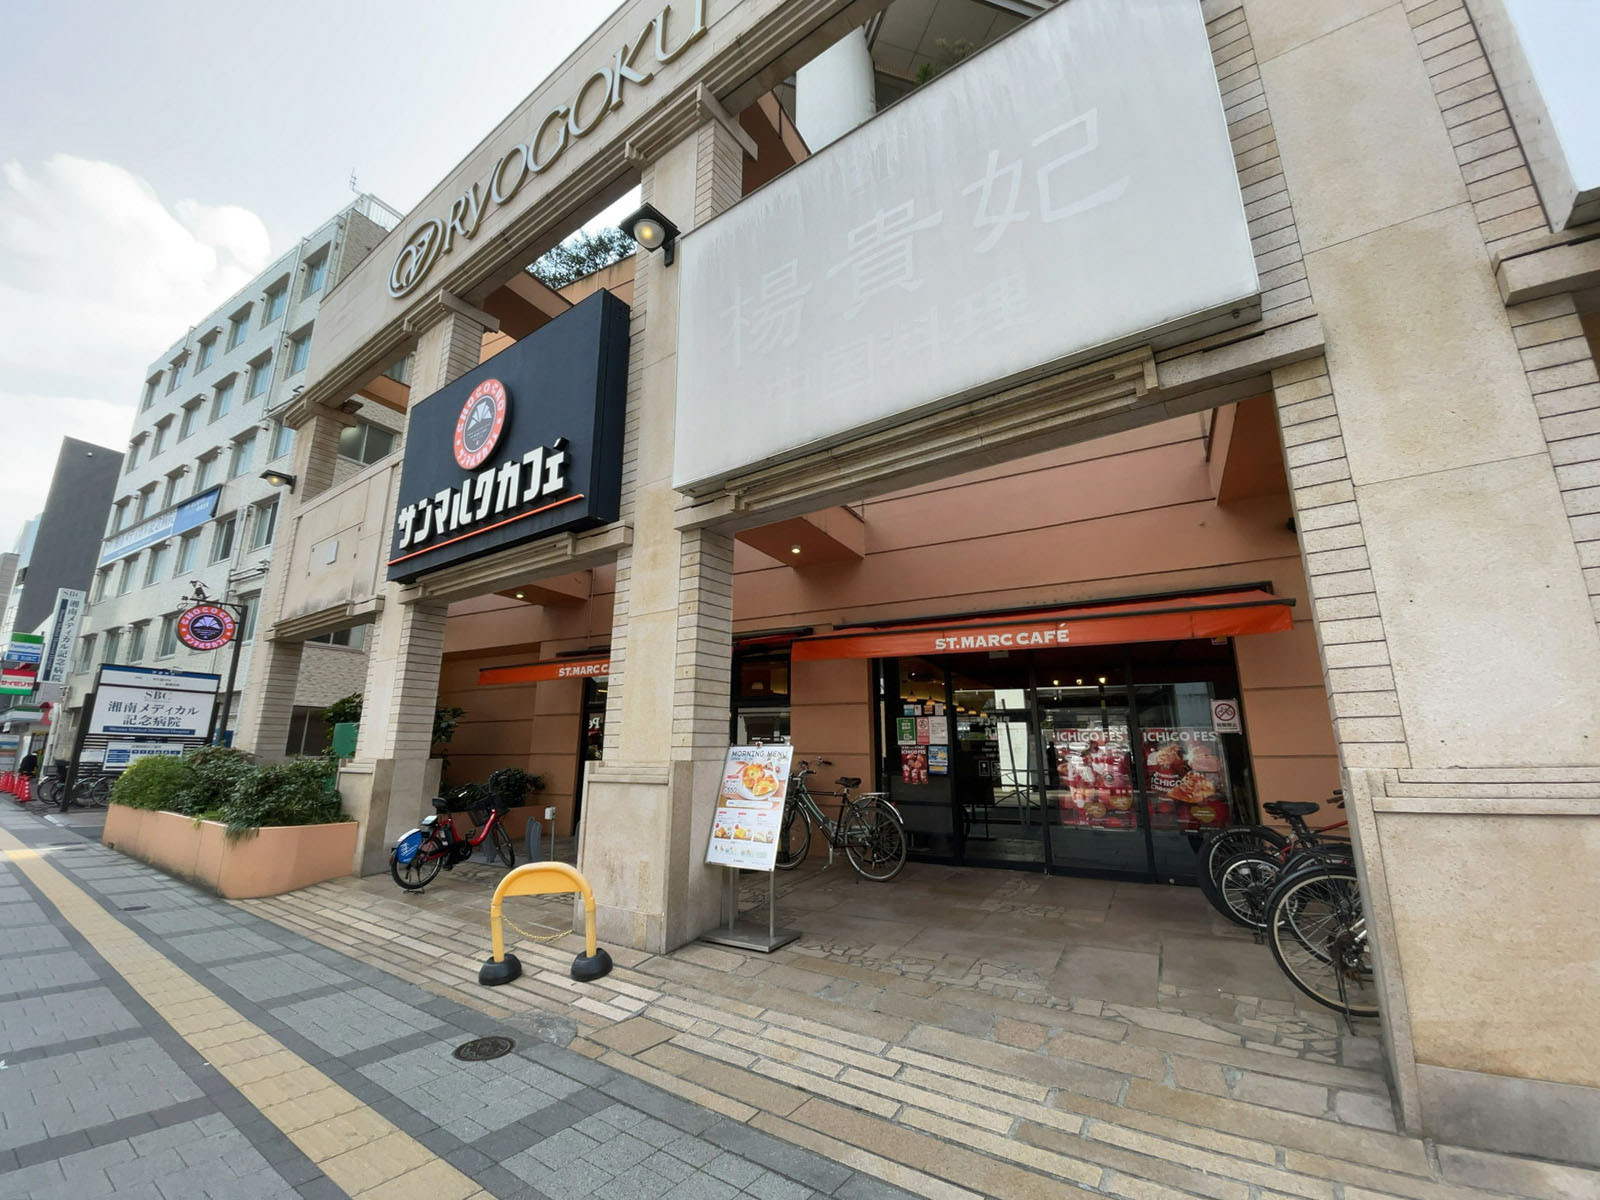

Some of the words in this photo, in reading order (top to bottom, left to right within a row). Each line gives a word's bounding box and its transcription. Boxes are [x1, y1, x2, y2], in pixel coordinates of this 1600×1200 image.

[442, 0, 707, 254] RYOGOKU
[718, 107, 1130, 370] 楊貴妃
[398, 437, 568, 550] サンマルクカフェ
[51, 600, 80, 683] 湘南メディカル記念病院
[935, 633, 1013, 650] ST.MARC
[1016, 623, 1070, 645] CAFÉ
[558, 664, 600, 677] ST.MARC
[144, 690, 173, 700] SBC
[107, 700, 200, 716] 湘南メディカル
[122, 713, 182, 727] 記念病院
[1056, 731, 1100, 741] ICHIGO
[1102, 731, 1124, 741] FES
[1143, 731, 1190, 742] ICHIGO
[1193, 731, 1218, 741] FES
[767, 750, 787, 758] MENU
[1151, 777, 1182, 787] ICHIGO
